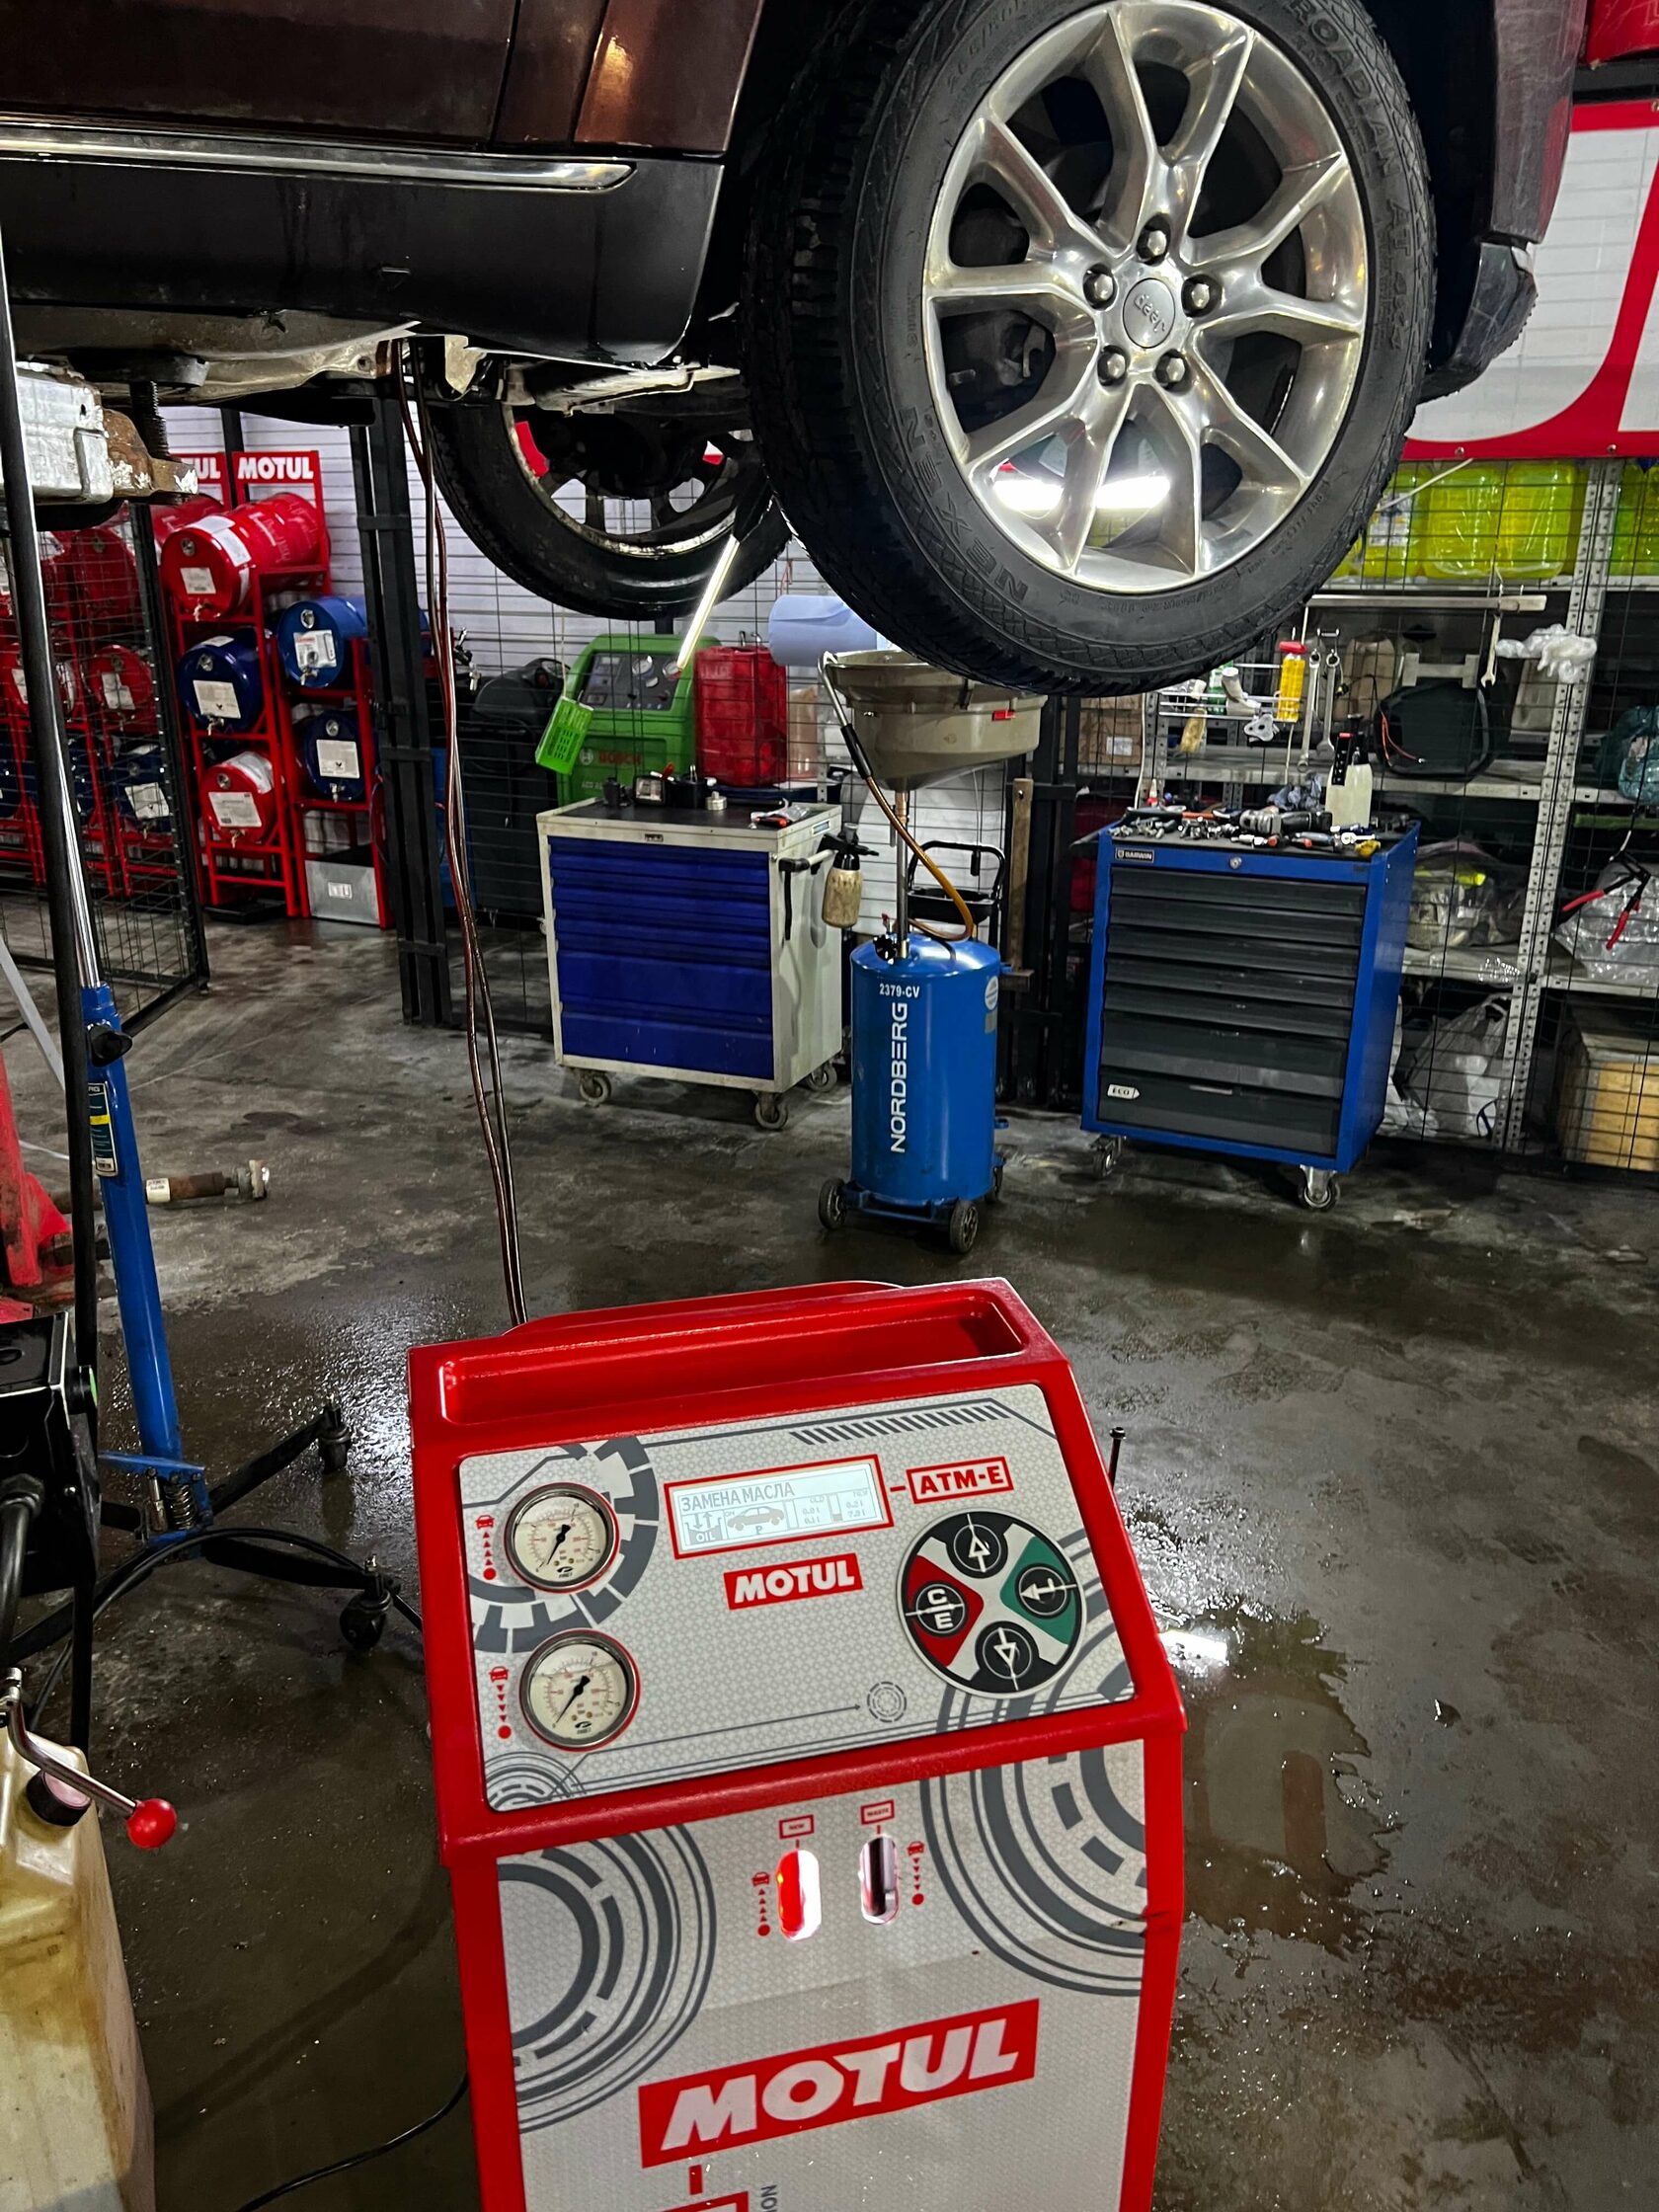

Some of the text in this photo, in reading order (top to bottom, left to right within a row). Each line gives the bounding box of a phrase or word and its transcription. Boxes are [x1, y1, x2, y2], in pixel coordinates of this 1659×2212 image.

[238, 457, 314, 480] MOTUL
[899, 406, 1029, 602] NEXEN
[891, 1002, 908, 1153] NORDBERG
[919, 1465, 1004, 1495] ATM-E
[680, 1481, 796, 1513] ЗАМЕНА МАСЛА
[695, 1532, 716, 1541] OIL
[734, 1560, 855, 1604] MOTUL
[926, 1588, 948, 1605] C
[934, 1612, 954, 1630] E
[660, 2018, 1019, 2152] MOTUL
